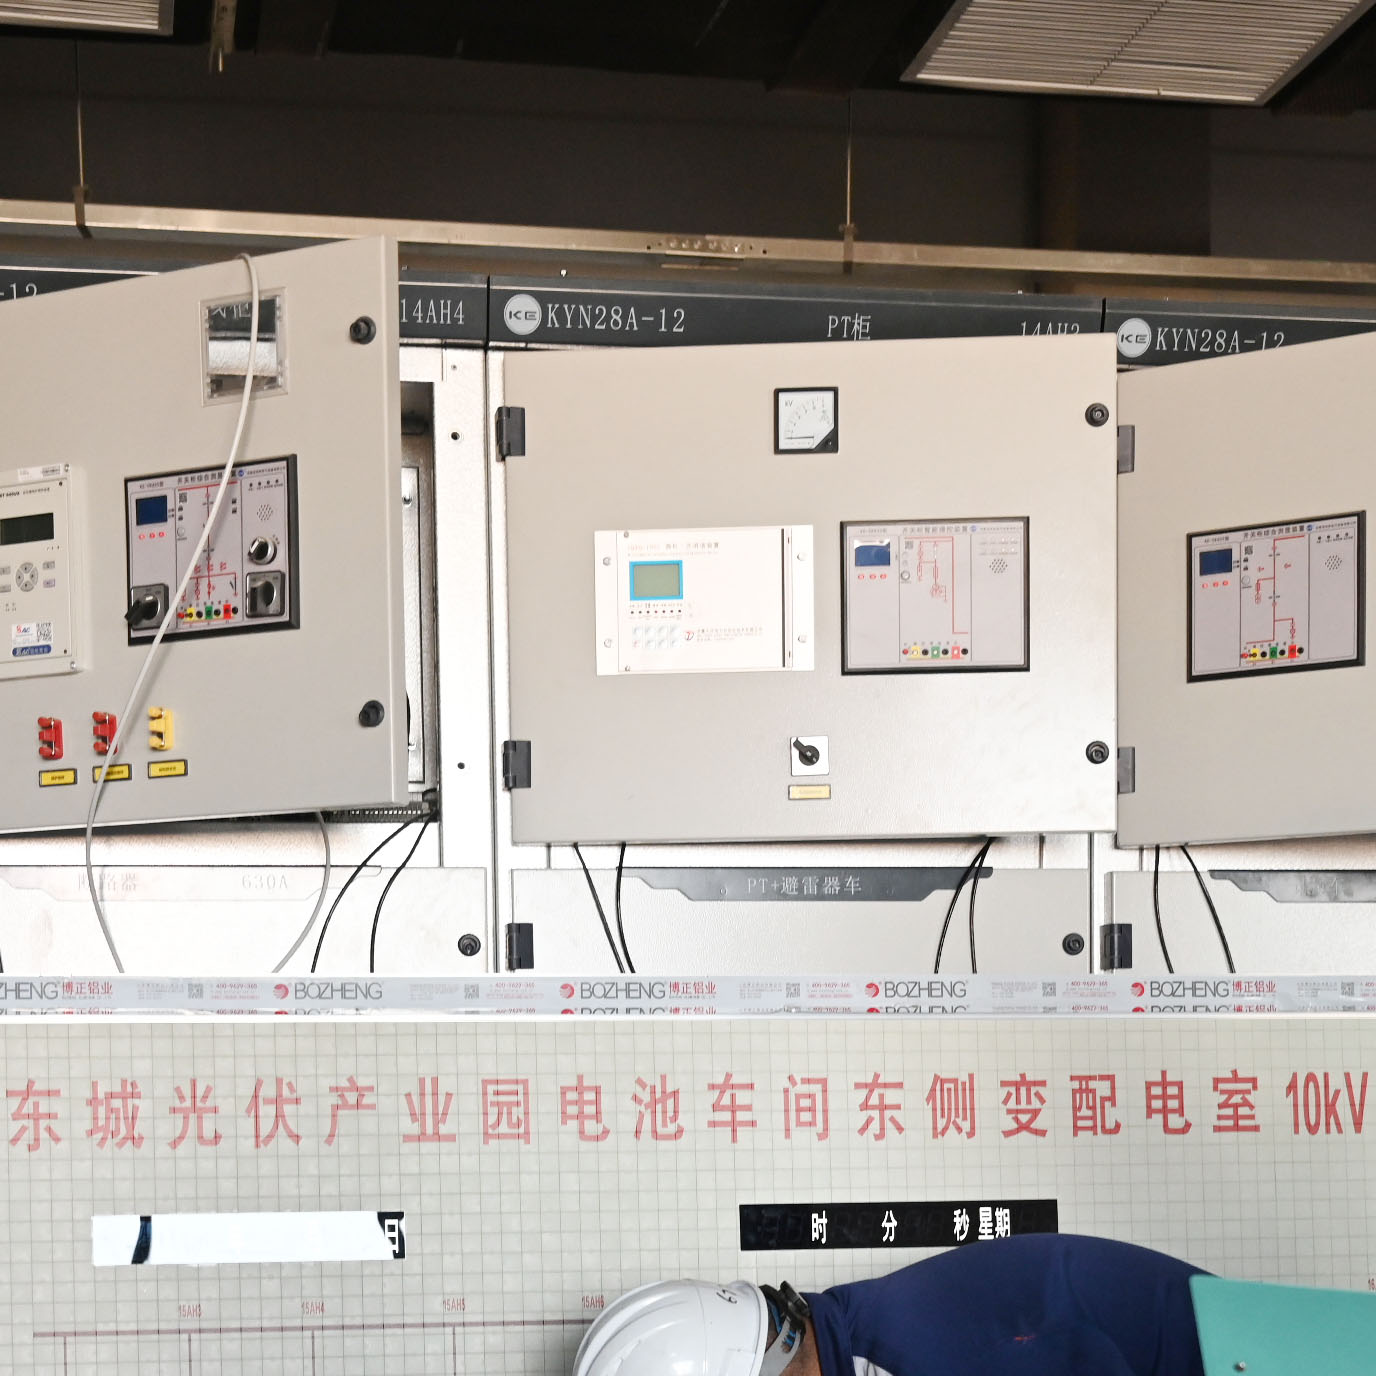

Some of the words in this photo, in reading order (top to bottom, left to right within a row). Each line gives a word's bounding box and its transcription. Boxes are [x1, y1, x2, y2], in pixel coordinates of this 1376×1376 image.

[399, 300, 465, 326] 14AH4
[547, 303, 685, 333] KYN28A-12
[827, 313, 871, 341] PT柜
[1155, 327, 1285, 353] KYN28A-12
[242, 873, 289, 890] 630A
[746, 875, 862, 896] PT+避雷器车
[62, 981, 112, 995] 博正铝业
[294, 982, 383, 1000] BOZHENG
[580, 982, 665, 999] BOZHENG
[669, 981, 716, 995] 博正铝业
[884, 981, 966, 998] BOZHENG
[1150, 981, 1229, 998] BOZHENG
[1232, 980, 1276, 993] 博正铝业
[811, 1210, 828, 1244] 时
[881, 1209, 898, 1242] 分
[953, 1208, 970, 1242] 秒
[978, 1206, 1011, 1240] 星期
